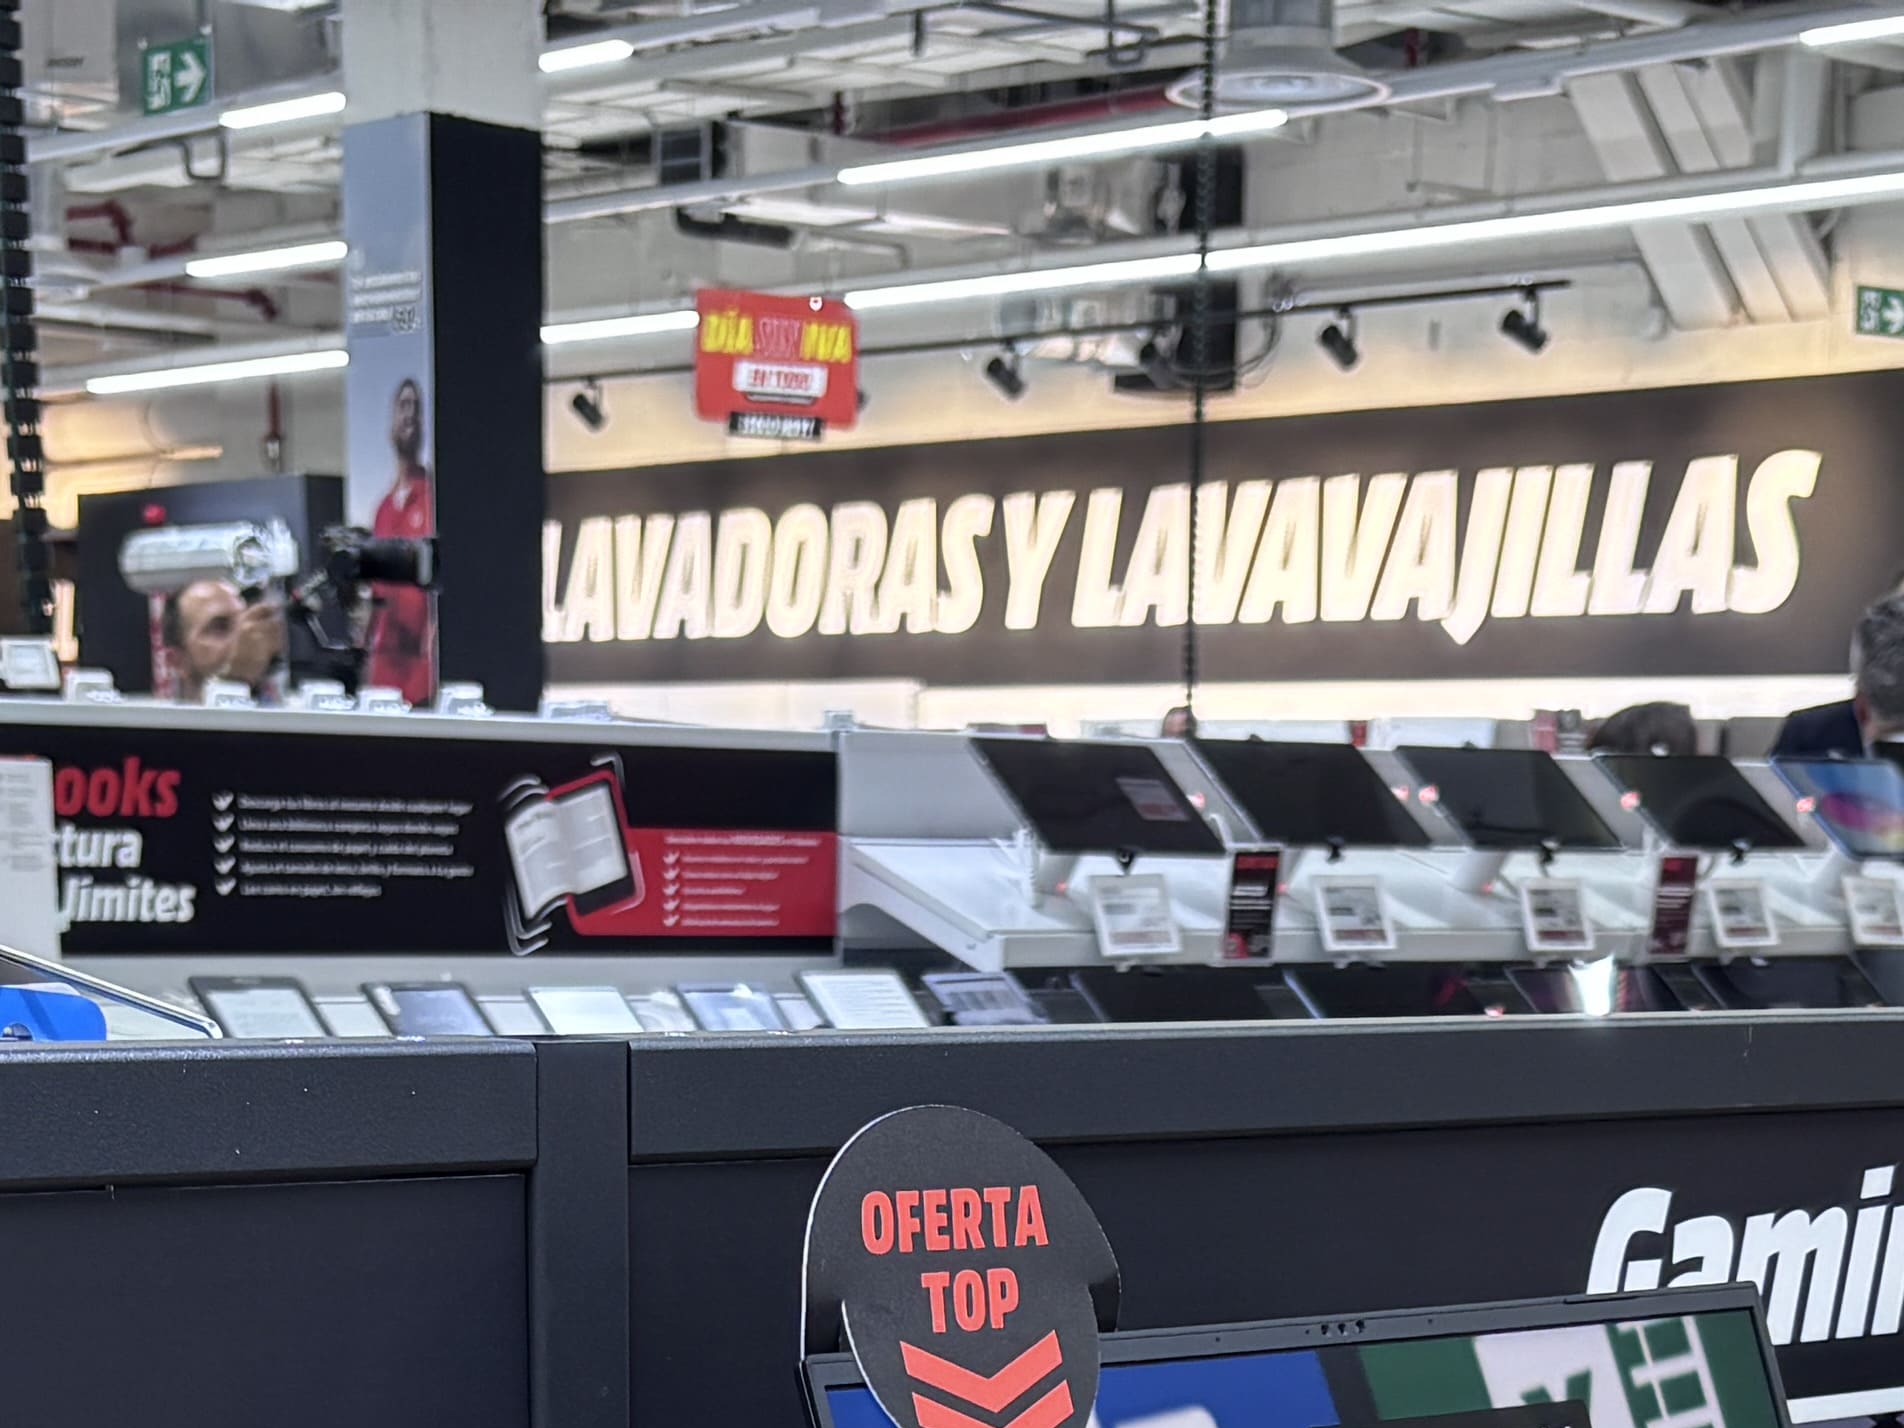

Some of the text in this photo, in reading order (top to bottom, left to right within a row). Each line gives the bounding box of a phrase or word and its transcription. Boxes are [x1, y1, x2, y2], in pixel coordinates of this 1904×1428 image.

[541, 448, 1824, 646] LAVADORAS Y LAVAVAJILLAS
[861, 1184, 1049, 1256] OFERTA
[920, 1267, 1020, 1334] TOP
